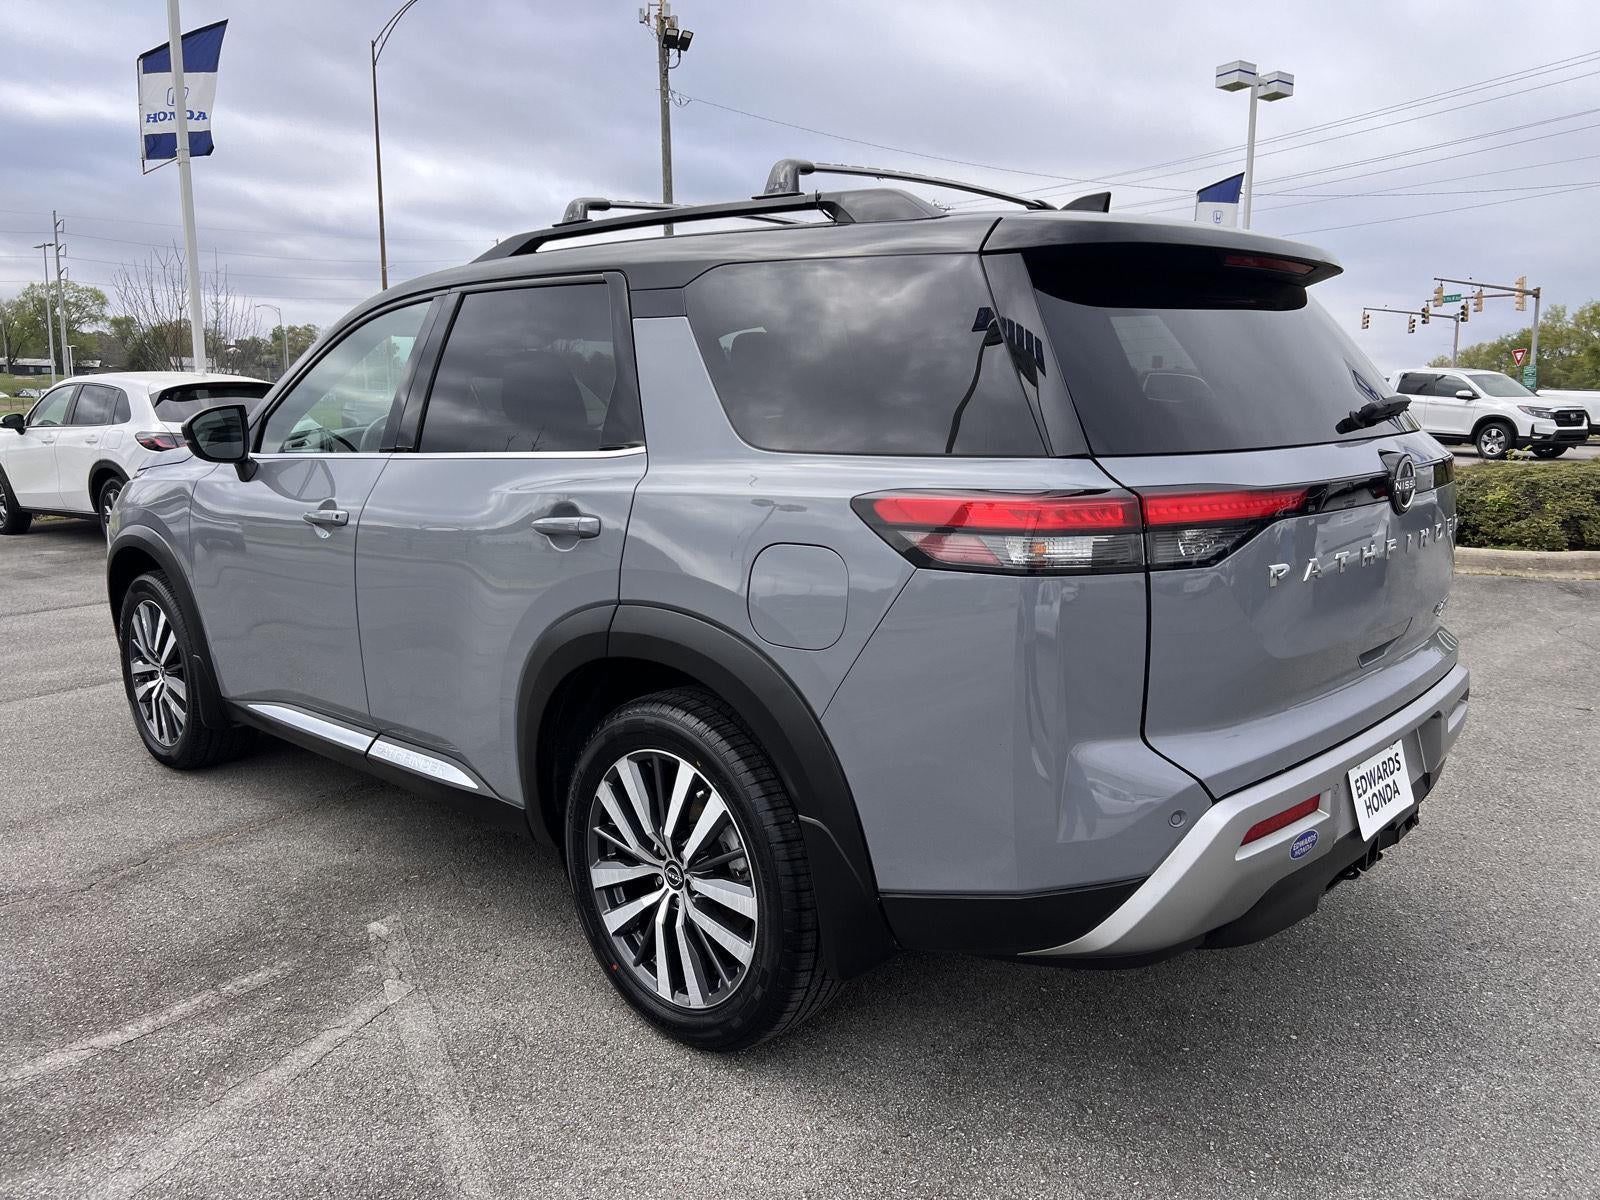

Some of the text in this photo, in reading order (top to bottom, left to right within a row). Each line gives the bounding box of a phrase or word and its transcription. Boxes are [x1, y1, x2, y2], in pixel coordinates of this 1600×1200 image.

[1395, 480, 1415, 491] NISS
[1354, 752, 1401, 799] EDWARDS
[1364, 779, 1401, 819] HONDA
